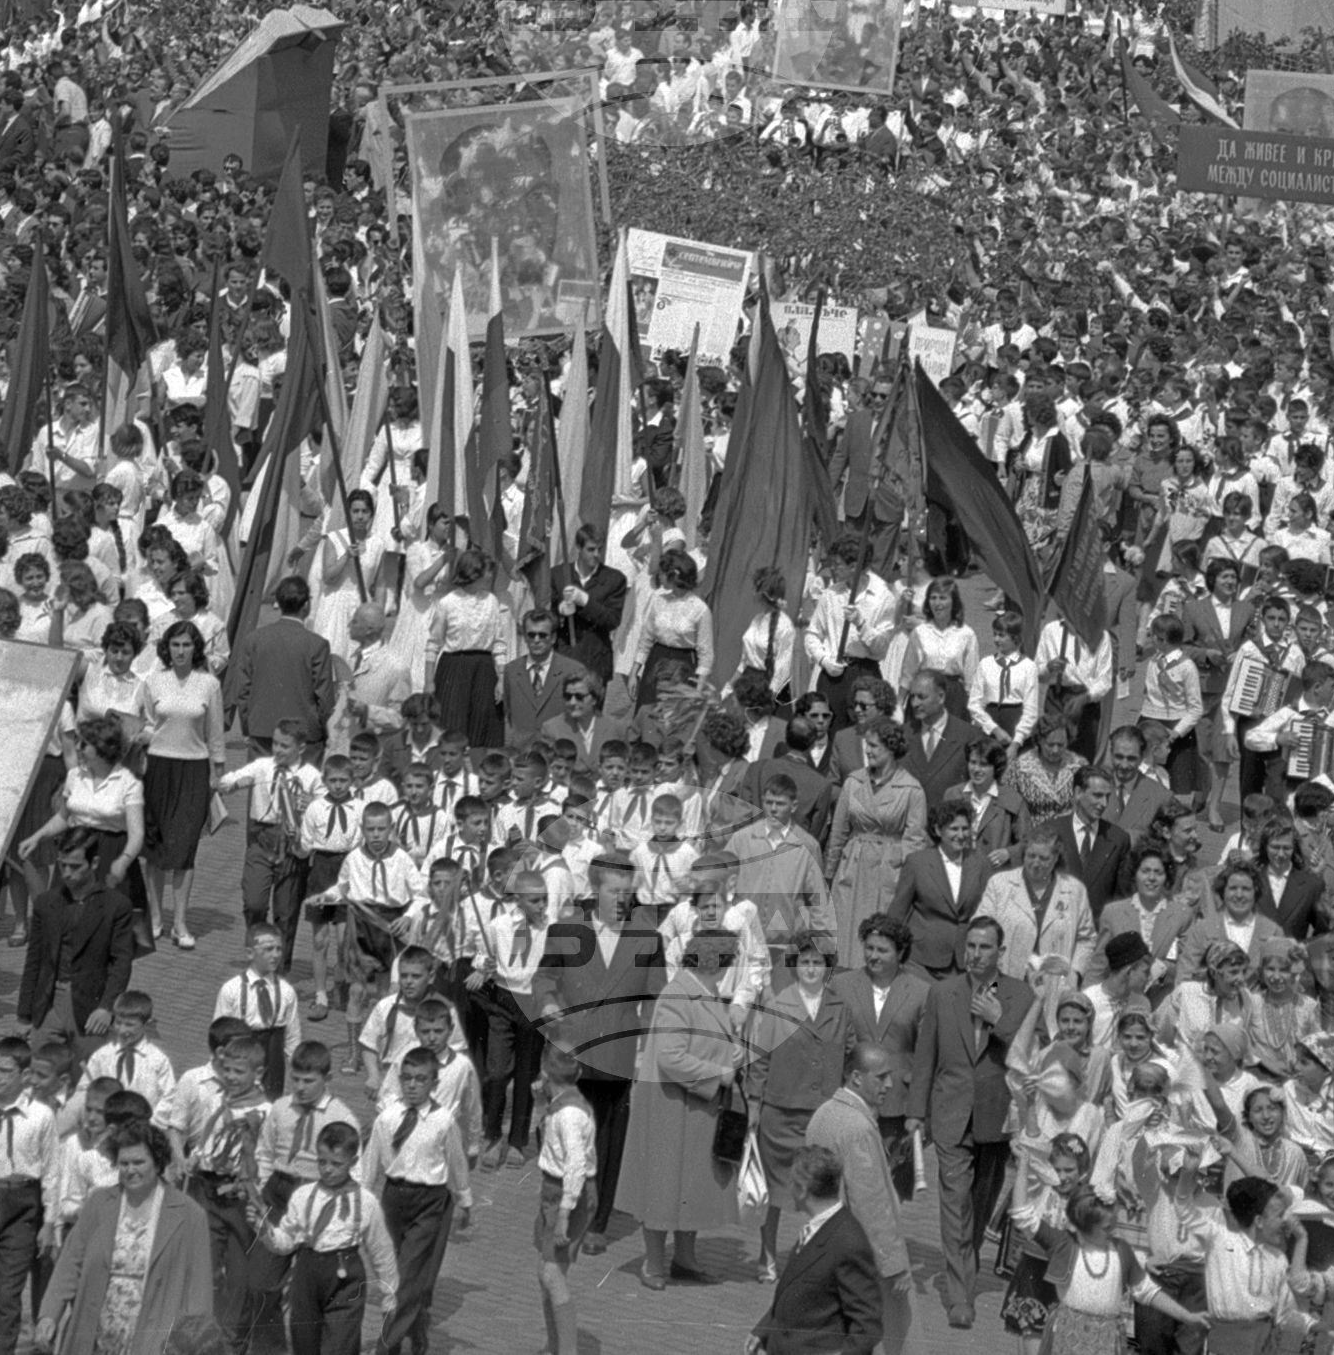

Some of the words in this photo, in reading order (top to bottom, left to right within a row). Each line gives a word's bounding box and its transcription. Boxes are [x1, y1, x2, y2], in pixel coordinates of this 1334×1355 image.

[1217, 138, 1237, 161] ДА
[1244, 141, 1287, 163] ЖИВЕЕ
[1296, 146, 1306, 164] И
[1207, 164, 1255, 189] МЕЖДУ
